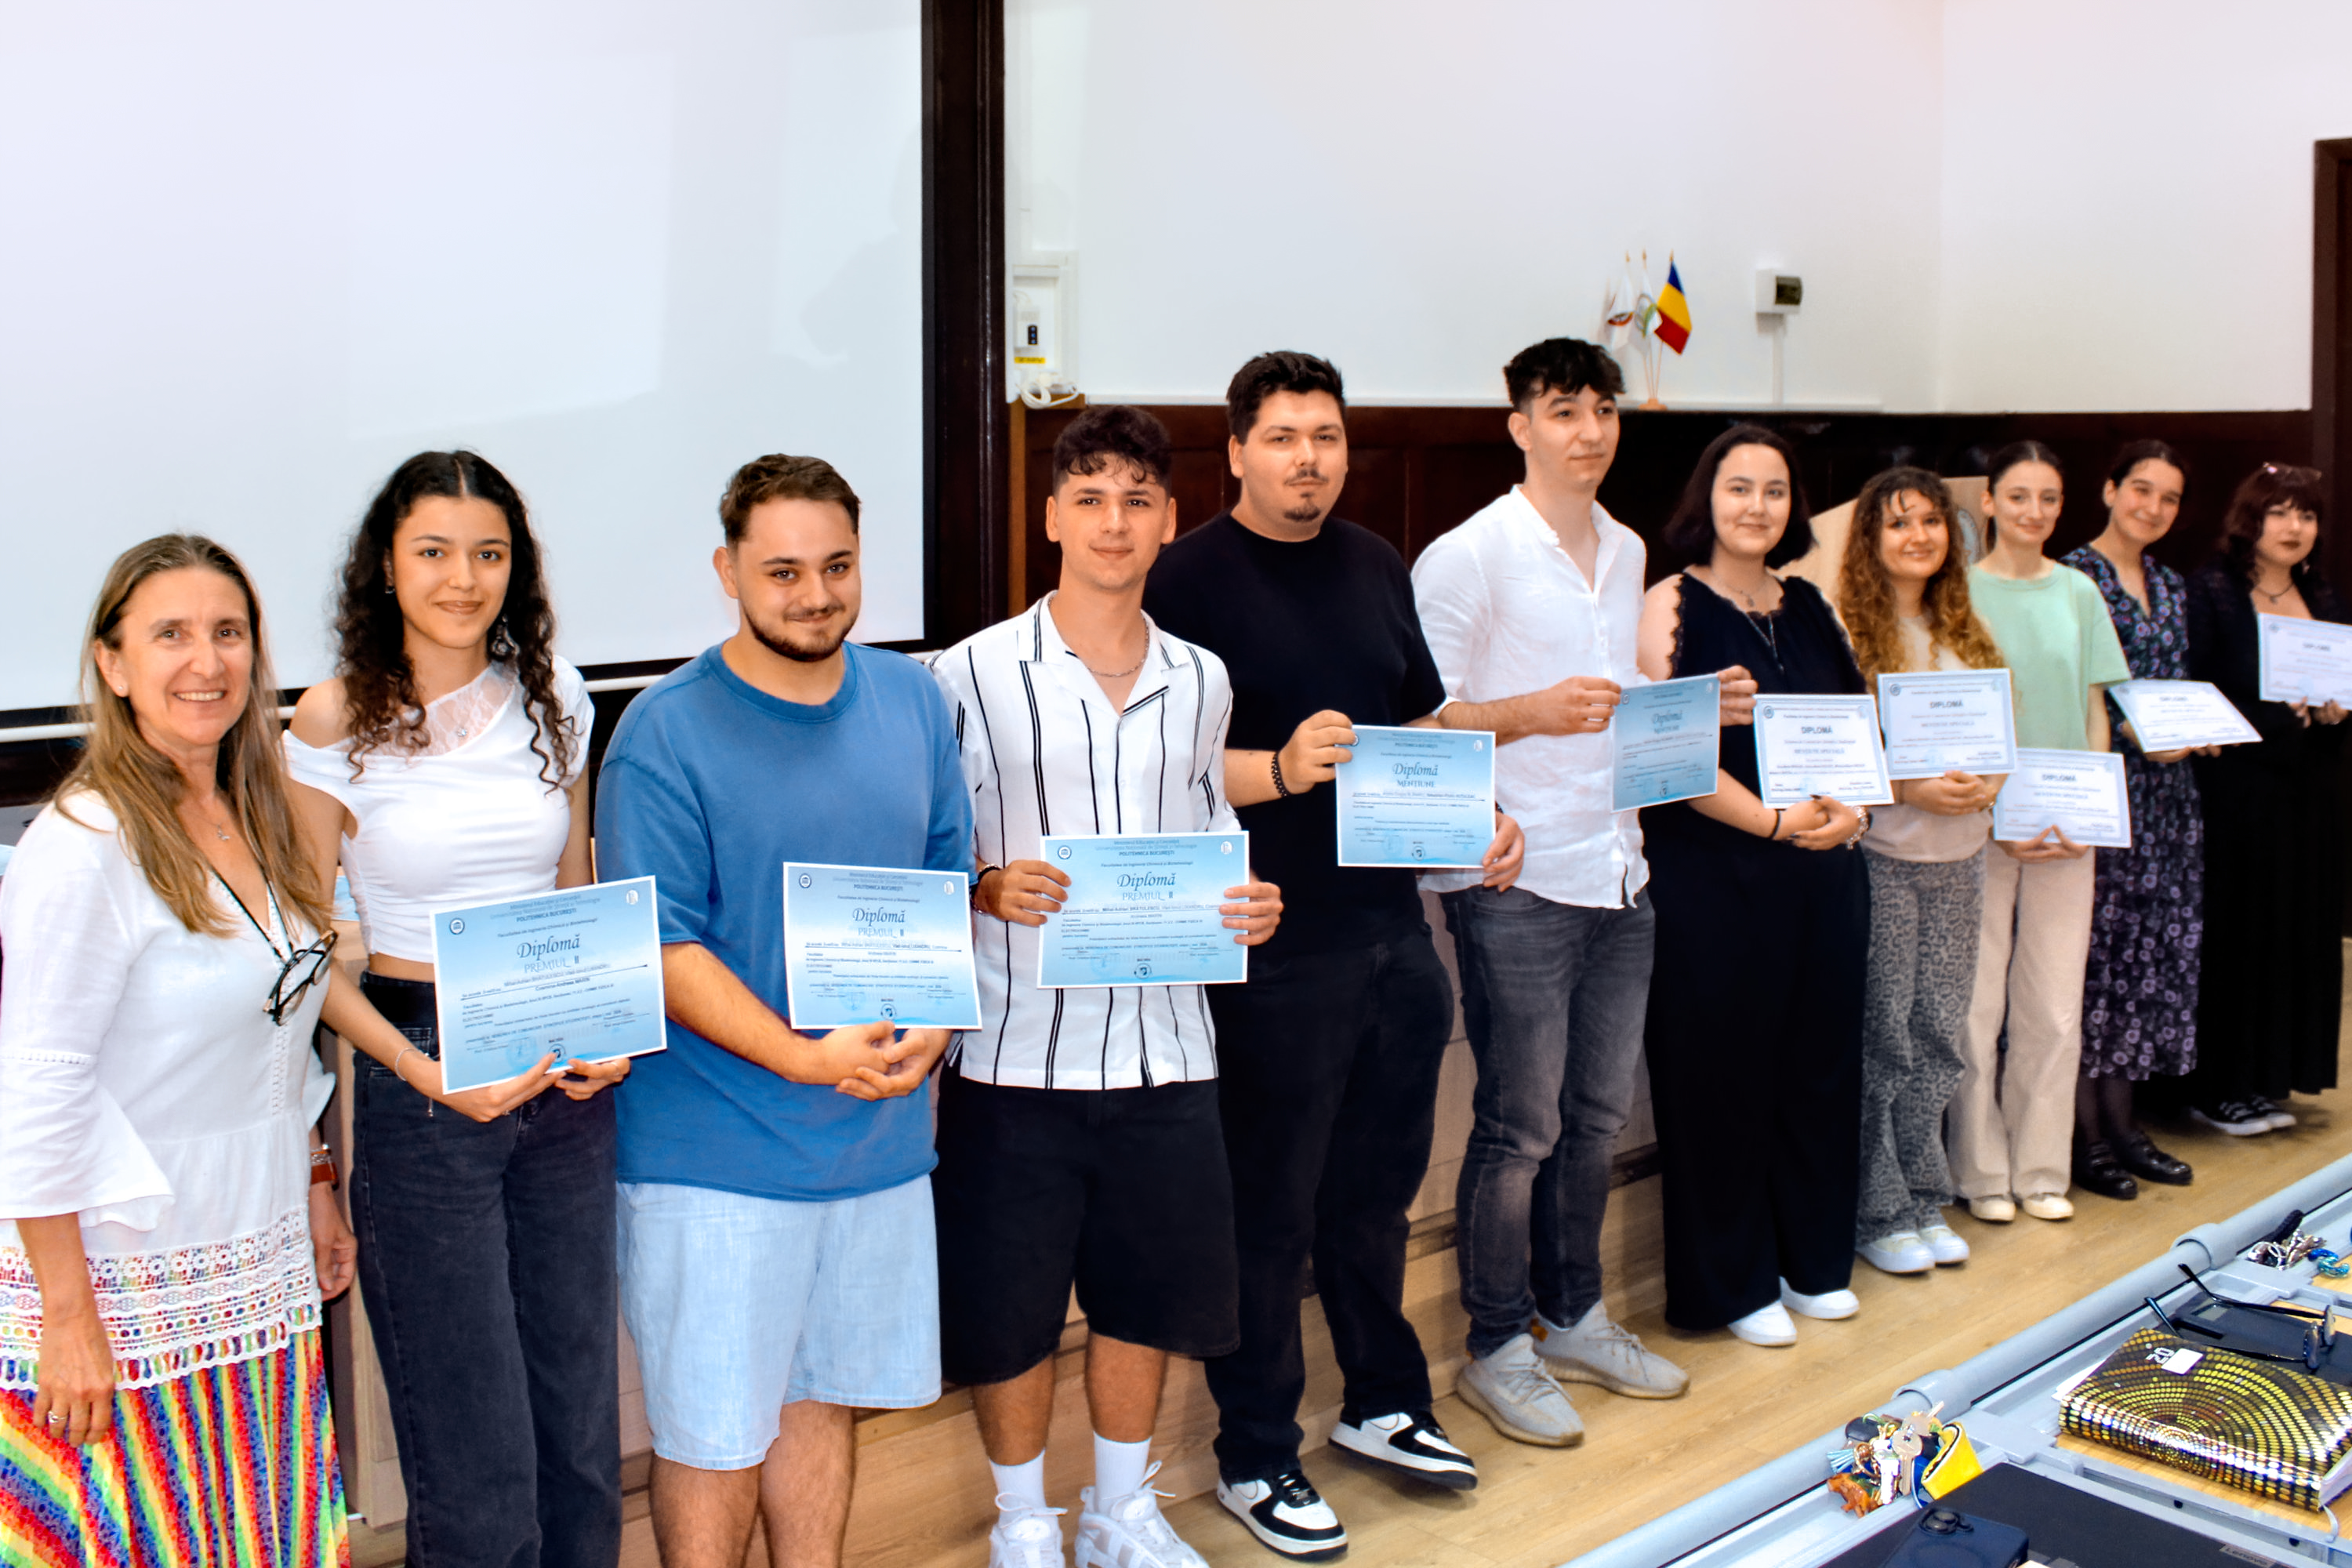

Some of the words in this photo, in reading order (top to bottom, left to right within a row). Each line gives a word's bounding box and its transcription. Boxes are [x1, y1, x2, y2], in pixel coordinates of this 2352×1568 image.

[1392, 762, 1439, 779] Diplomă
[1116, 872, 1177, 891] Diplomă
[852, 906, 906, 927] Diplomă
[517, 933, 580, 960] Diplomă
[2145, 1347, 2176, 1365] 20
